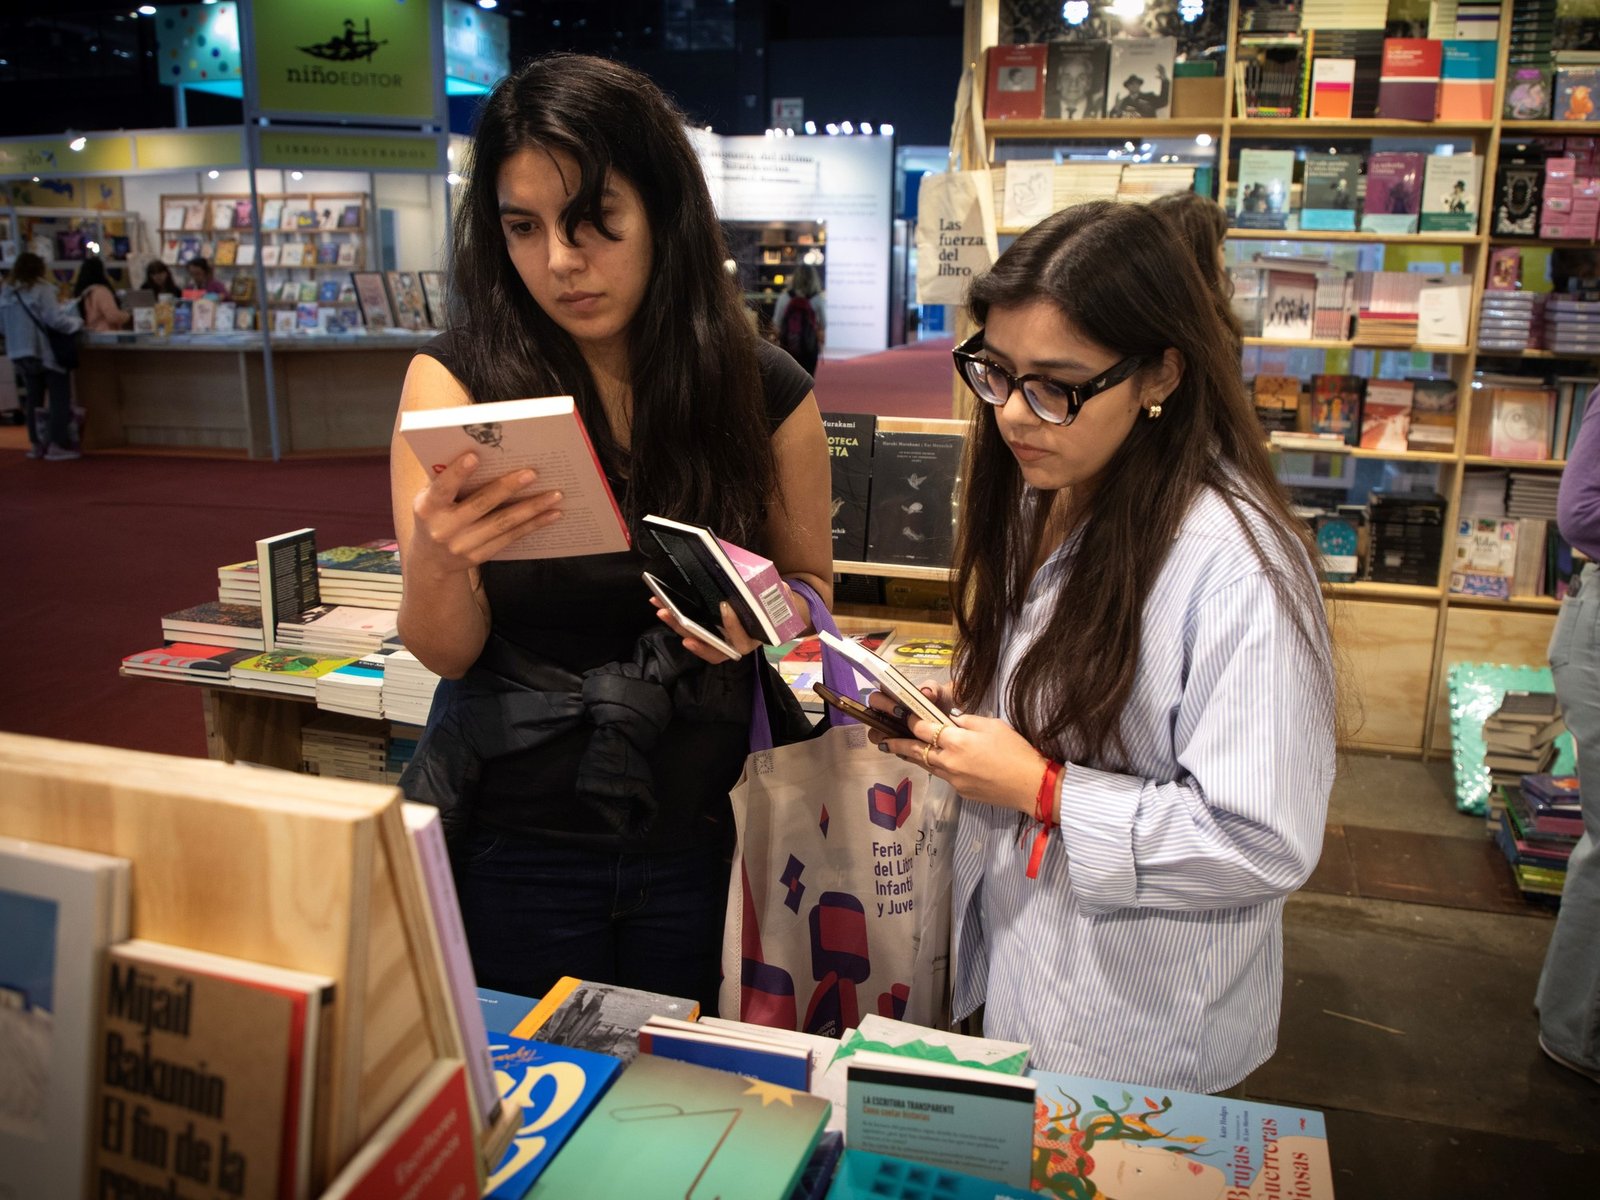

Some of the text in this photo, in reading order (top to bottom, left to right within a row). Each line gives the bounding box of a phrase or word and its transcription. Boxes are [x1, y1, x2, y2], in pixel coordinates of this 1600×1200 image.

[939, 218, 962, 231] Las
[939, 233, 987, 247] fuerza
[938, 248, 958, 261] del
[938, 263, 972, 277] libro
[827, 436, 859, 446] OTECA
[896, 646, 955, 655] CARO
[872, 841, 903, 857] Feria
[874, 857, 913, 876] del Libr
[875, 876, 913, 896] Infanti
[877, 899, 913, 918] y Juve
[104, 1029, 226, 1122] Bakunin
[863, 1095, 955, 1115] LA ESCRITURA TRANSPARENTE
[102, 1095, 126, 1154] El
[131, 1104, 170, 1169] fin
[174, 1120, 213, 1186] de
[217, 1131, 248, 1197] la
[1287, 1152, 1312, 1200] iosas
